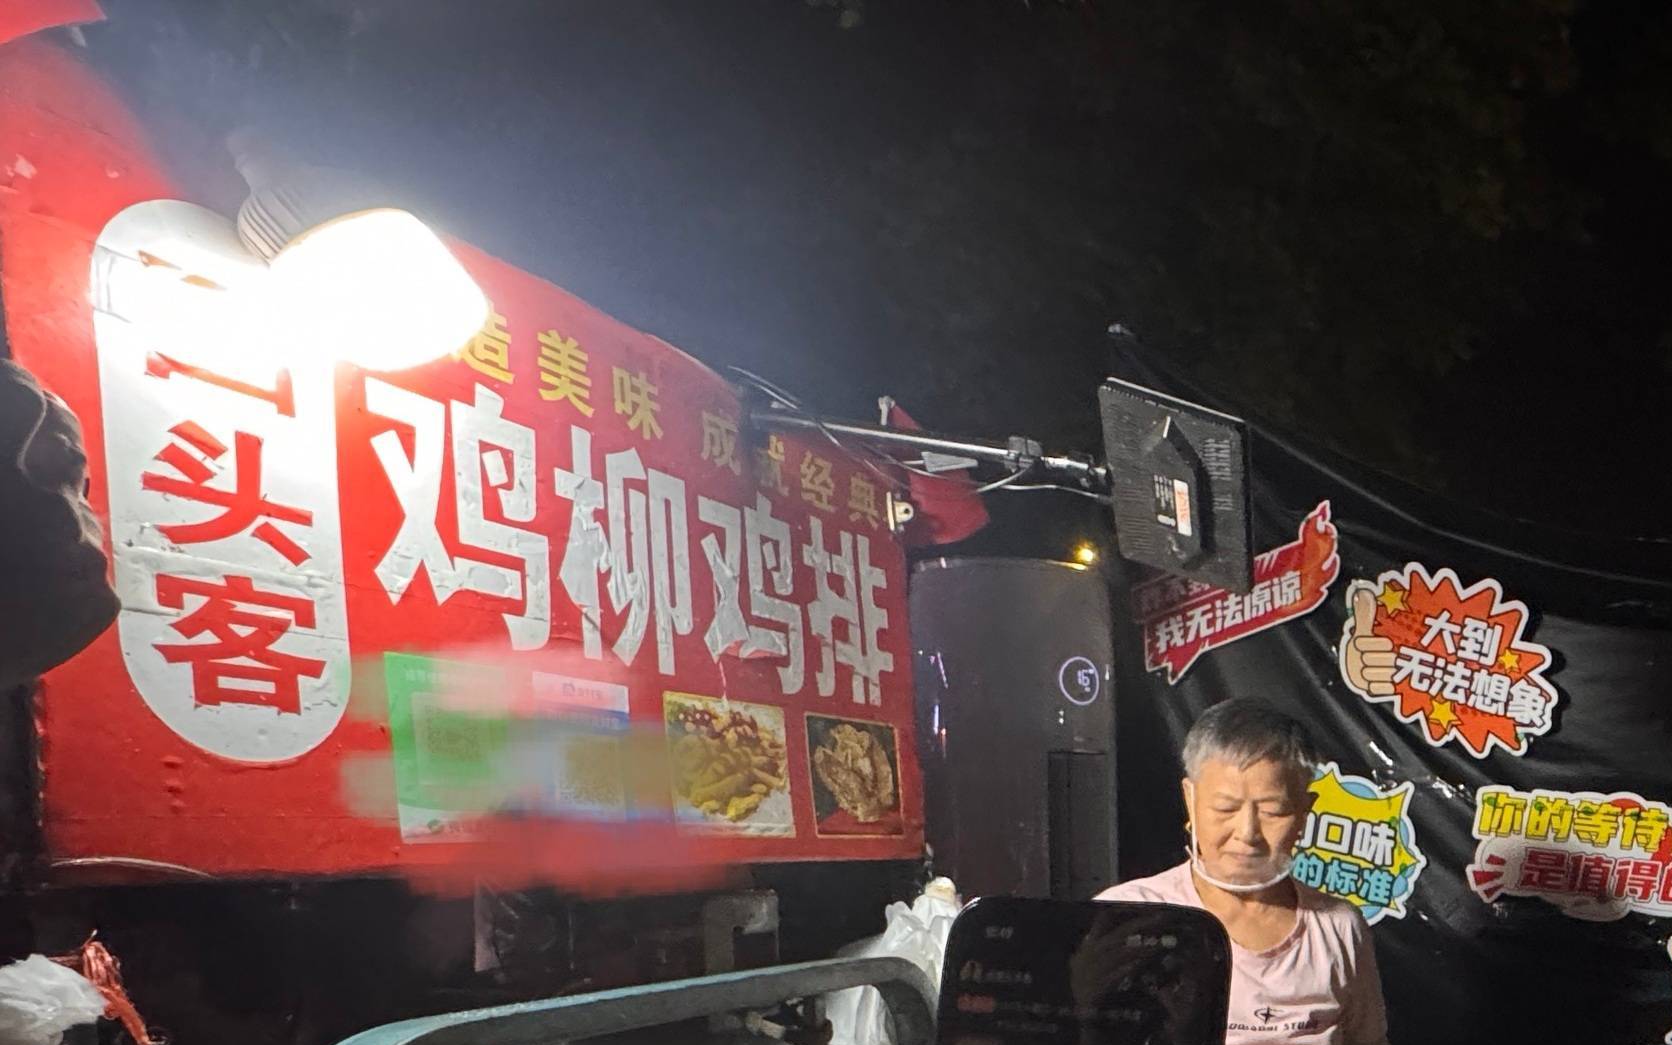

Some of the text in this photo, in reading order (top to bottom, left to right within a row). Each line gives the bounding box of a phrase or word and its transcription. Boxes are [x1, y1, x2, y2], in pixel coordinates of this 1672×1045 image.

[365, 376, 894, 708] 鸡柳鸡排
[1155, 570, 1302, 654] 我无法原谅
[1420, 610, 1503, 667] 大到
[1392, 646, 1546, 728] 无法想象
[1478, 791, 1668, 853] 你的等待
[1293, 852, 1394, 906] 的标准
